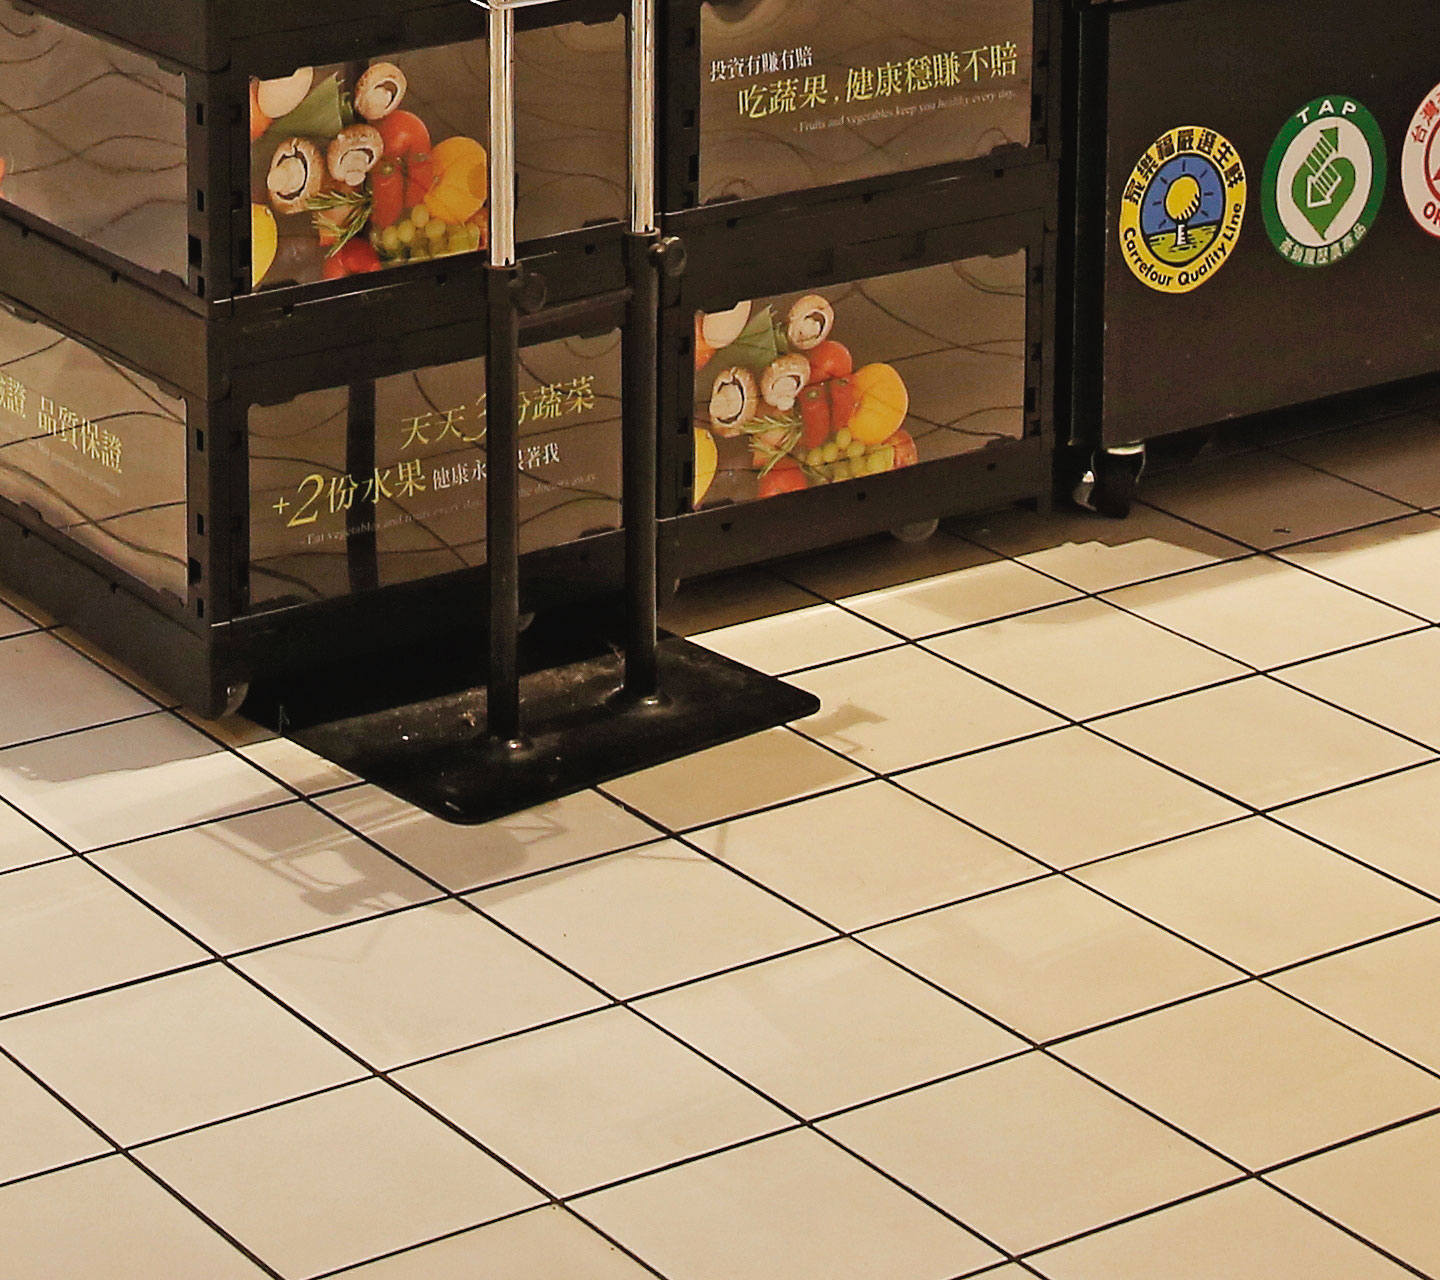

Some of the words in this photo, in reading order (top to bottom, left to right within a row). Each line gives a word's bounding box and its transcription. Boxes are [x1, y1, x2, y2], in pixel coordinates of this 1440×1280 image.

[709, 45, 815, 83] 投資有賺有賠
[1296, 99, 1358, 125] TAP
[1126, 128, 1245, 208] 家樂福嚴選生鮮
[1122, 225, 1175, 288] Carrefour
[1177, 244, 1228, 288] Quality
[1223, 202, 1244, 248] Line
[38, 395, 122, 474] 品質保證
[400, 375, 595, 450] 天天蔬菜
[272, 458, 425, 528] +2份水果
[432, 441, 560, 492] 健康永著我
